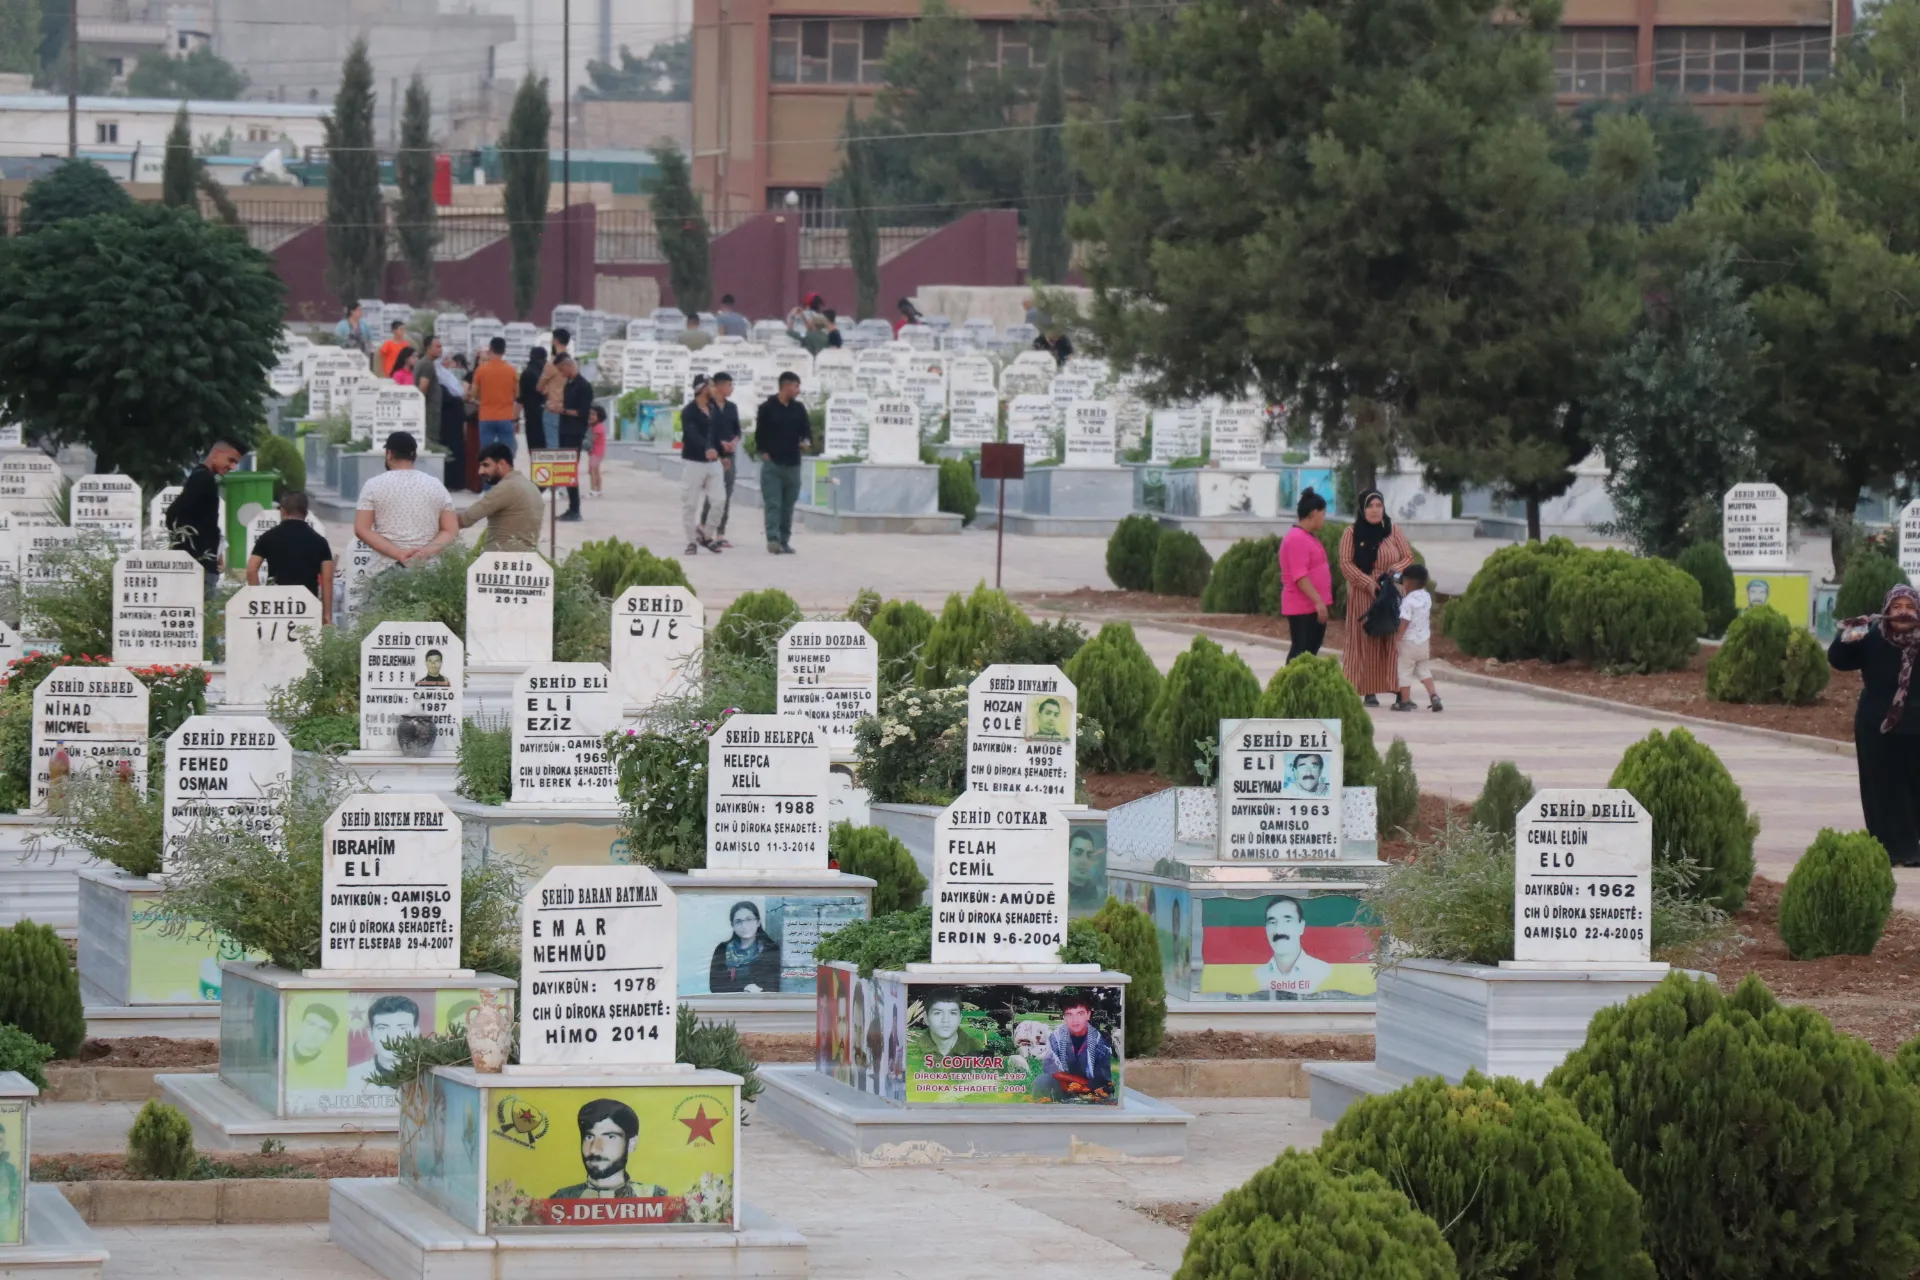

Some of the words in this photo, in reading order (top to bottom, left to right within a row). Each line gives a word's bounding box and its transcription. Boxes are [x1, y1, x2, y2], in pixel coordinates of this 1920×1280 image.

[123, 592, 157, 603] MERT
[495, 596, 528, 605] 2013
[161, 620, 195, 628] 1989
[825, 635, 866, 646] DOZDAR
[787, 654, 831, 663] MUHEMED
[421, 703, 447, 711] 1987
[836, 701, 860, 710] 1967
[984, 700, 1022, 713] HOZAN
[230, 733, 276, 746] FEHED
[179, 757, 228, 771] FEHED
[575, 753, 608, 763] 1969
[1029, 757, 1053, 766] 1993
[1243, 754, 1274, 770] ELÎ
[179, 777, 228, 791] OSMAN
[520, 779, 535, 788] TIL
[539, 779, 572, 788] BEREK
[972, 782, 989, 791] TEL
[775, 801, 815, 814] 1988
[1290, 805, 1330, 816] 1963
[414, 811, 444, 826] FERAT
[997, 811, 1048, 825] COTKAR
[715, 823, 729, 833] CIH
[1231, 834, 1245, 844] CIH
[1528, 829, 1558, 845] CEMAL
[767, 841, 815, 852] 11-3-2014
[948, 840, 996, 855] FELAH
[1286, 849, 1336, 859] 11-3-2014
[1540, 852, 1574, 867] ELO
[345, 858, 380, 876] ELÎ
[391, 890, 452, 903] QAMIŞLO
[579, 887, 612, 904] BARAN
[616, 886, 658, 903] BATMAN
[1587, 884, 1636, 897] 1962
[400, 906, 441, 918] 1989
[939, 911, 956, 923] CIH
[1524, 907, 1540, 918] CIH
[330, 921, 347, 933] CIH
[533, 918, 606, 937] EMAR
[1524, 926, 1577, 939] QAMIŞLO
[1585, 927, 1643, 940] 22-4-2005
[330, 938, 355, 950] BEYT
[359, 938, 402, 950] ELSEBAB
[407, 937, 454, 949] 29-4-2007
[938, 932, 986, 943] ERDIN
[993, 932, 1061, 945] 9-6-2004
[533, 940, 606, 963] MEHMÛD
[614, 977, 656, 992] 1978
[532, 1007, 551, 1020] CIH
[546, 1026, 598, 1044] HÎMO
[612, 1025, 659, 1042] 2014
[551, 1203, 663, 1224] Ş.DEVRIM
